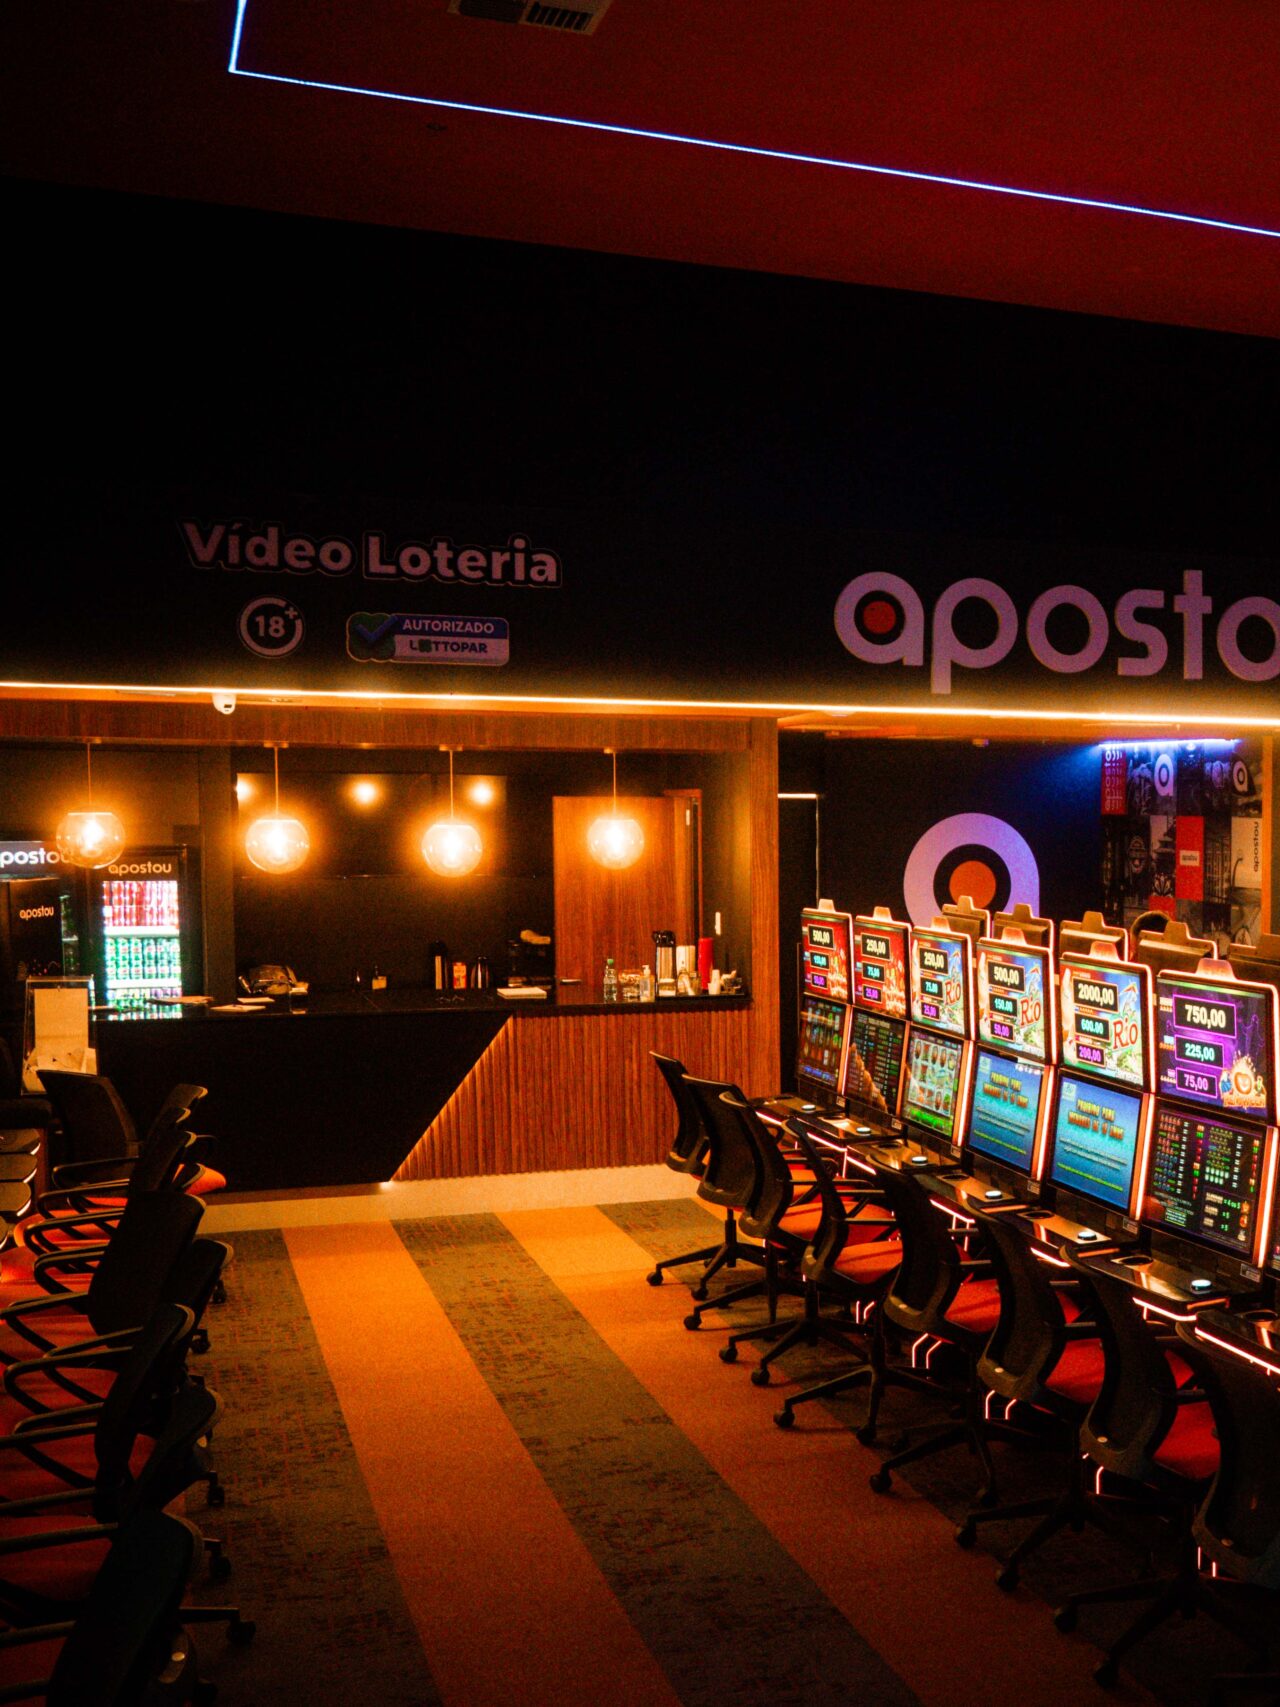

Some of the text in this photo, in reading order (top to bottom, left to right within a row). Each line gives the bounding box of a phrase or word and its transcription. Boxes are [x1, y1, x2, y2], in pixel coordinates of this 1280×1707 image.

[184, 521, 558, 583] Vídeo Loteria
[402, 619, 495, 634] AUTORIZADO
[108, 861, 172, 876] apostou
[20, 905, 54, 920] apostou
[993, 966, 1019, 986] 500,00
[1078, 983, 1115, 1006] 2000,00
[1020, 993, 1041, 1029] Rio
[1184, 1004, 1227, 1030] 750,00
[1112, 1016, 1138, 1050] Rio
[1184, 1042, 1215, 1062] 225,00
[1183, 1074, 1209, 1091] 75,00
